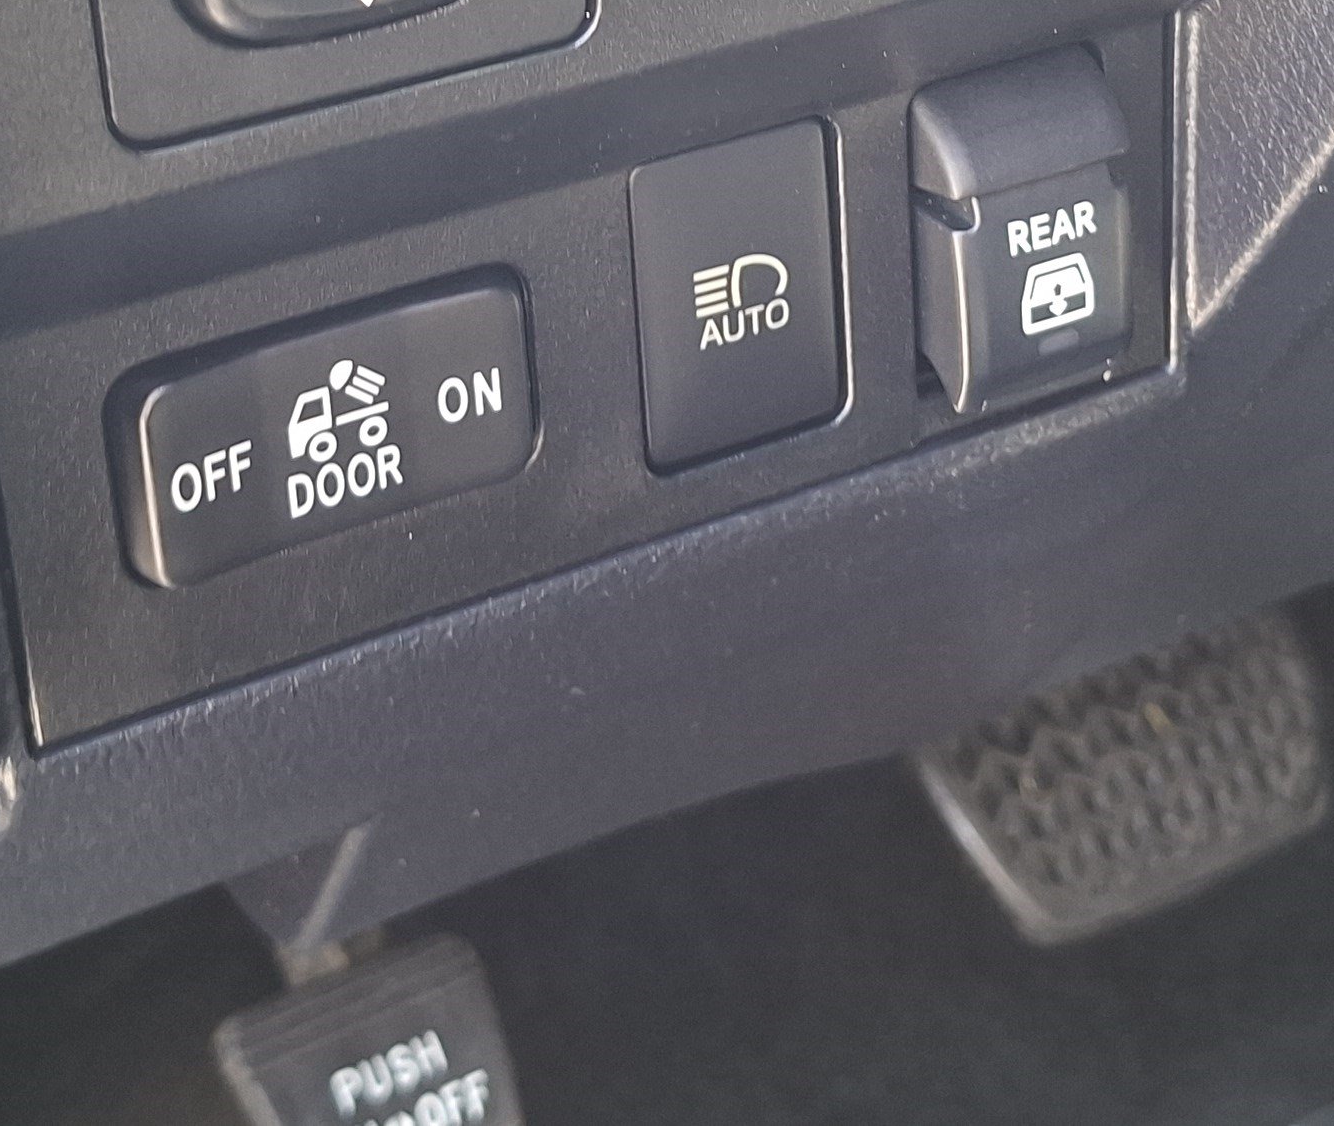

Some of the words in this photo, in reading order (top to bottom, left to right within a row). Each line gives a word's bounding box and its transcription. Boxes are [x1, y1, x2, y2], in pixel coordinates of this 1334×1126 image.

[1006, 200, 1098, 258] REAR
[698, 297, 791, 351] AUTO
[436, 366, 503, 424] ON
[170, 439, 253, 513] OFF
[286, 443, 404, 520] DOOR
[329, 1028, 449, 1121] PUSH
